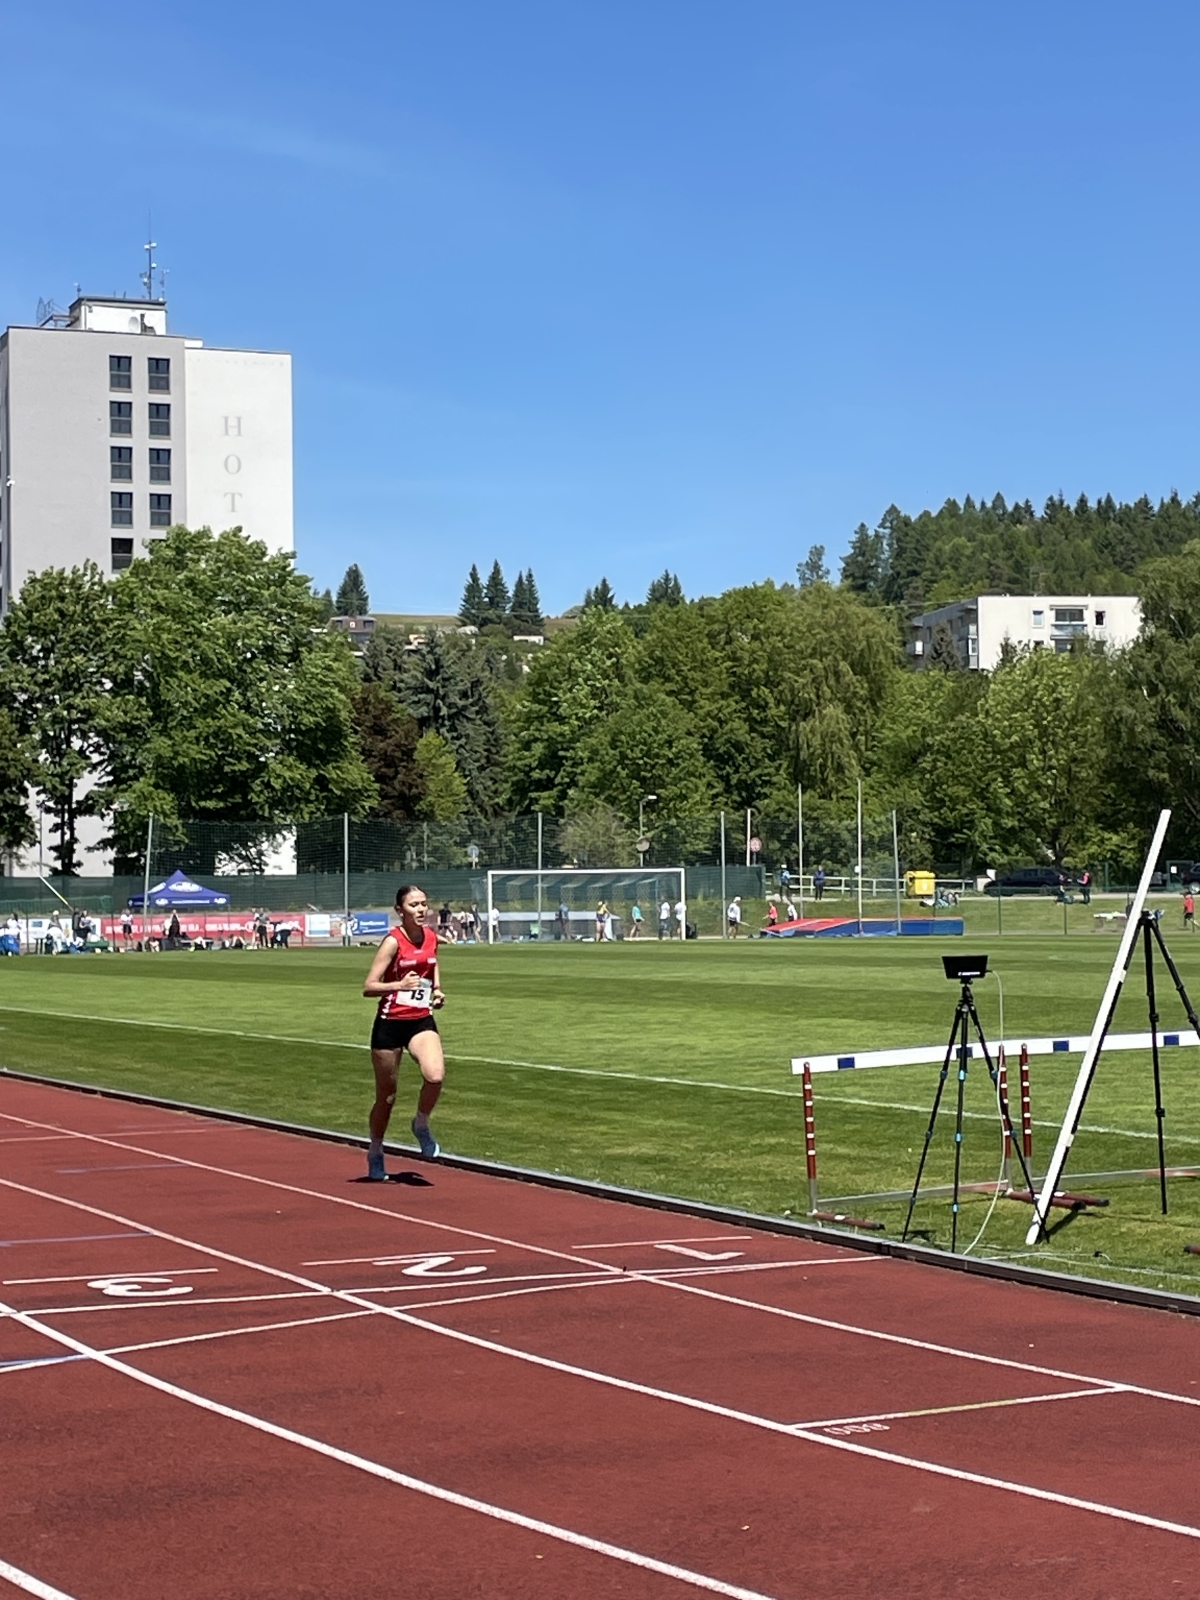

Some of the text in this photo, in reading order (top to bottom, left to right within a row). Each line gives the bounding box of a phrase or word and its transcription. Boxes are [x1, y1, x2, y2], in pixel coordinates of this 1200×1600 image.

[410, 989, 425, 1001] 15
[372, 1256, 488, 1278] 2
[86, 1276, 194, 1297] 3
